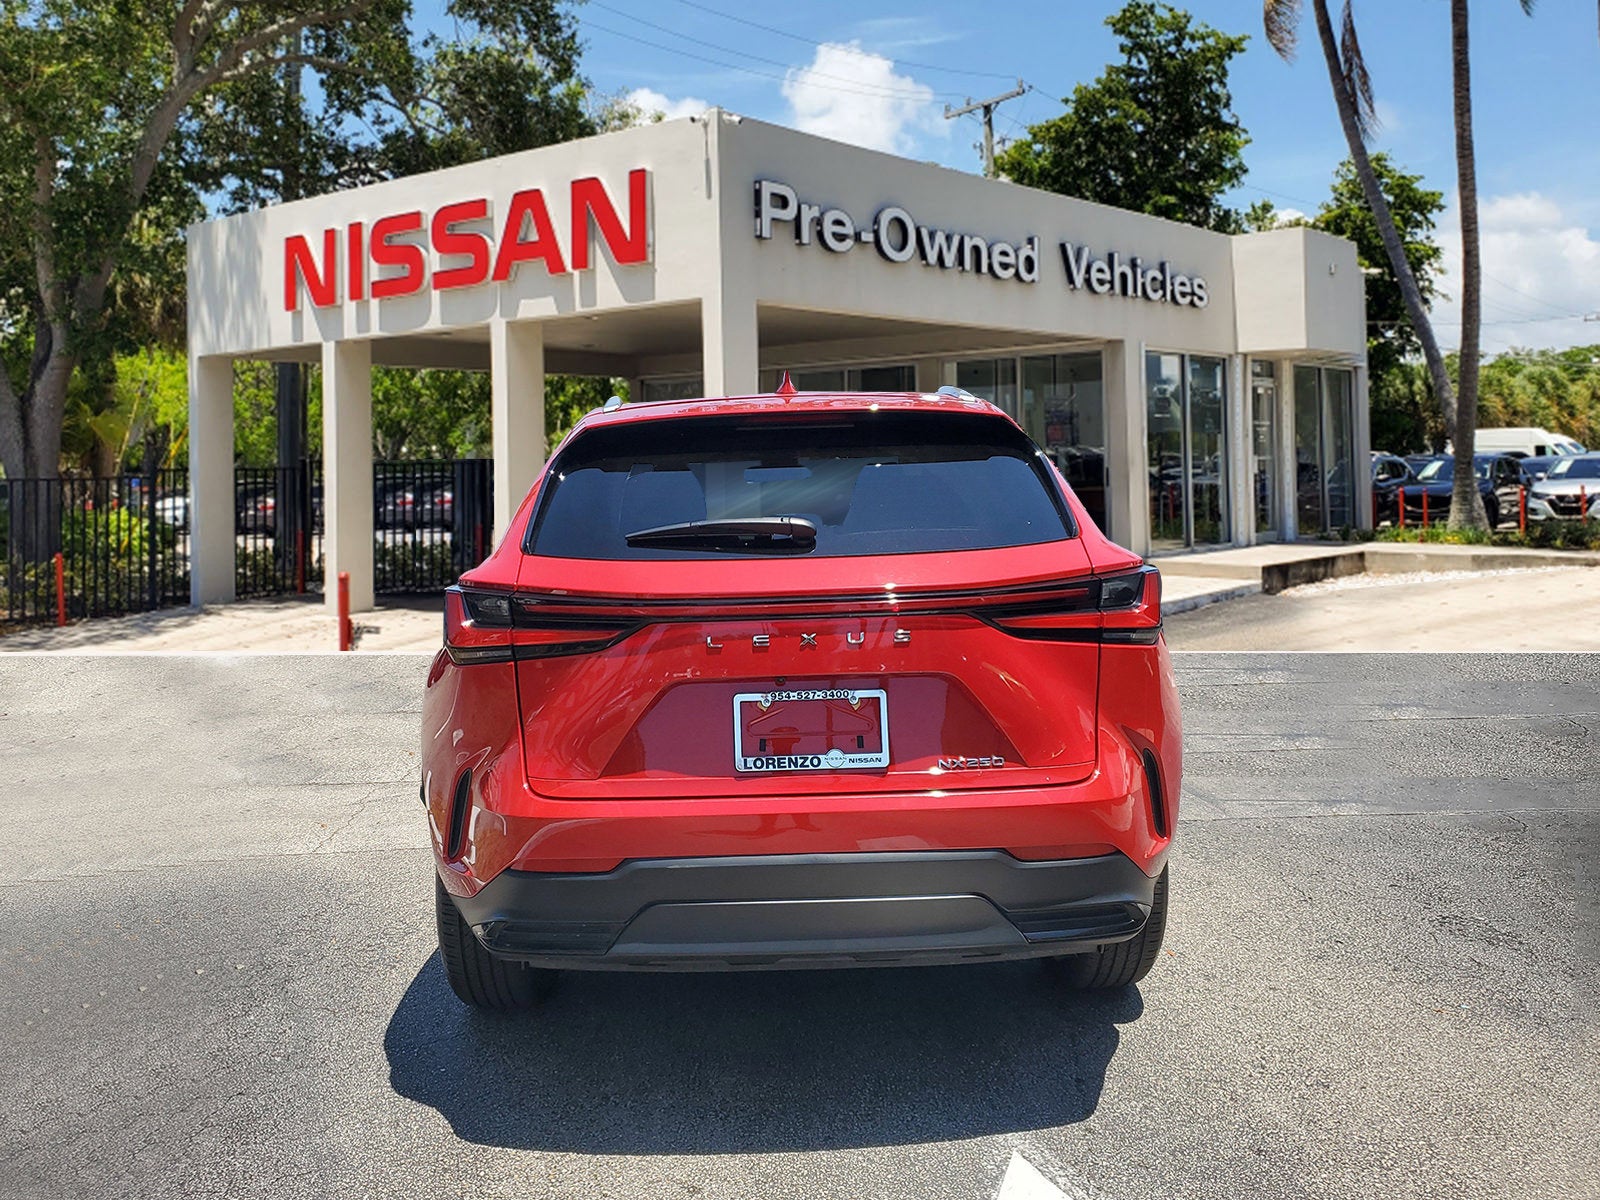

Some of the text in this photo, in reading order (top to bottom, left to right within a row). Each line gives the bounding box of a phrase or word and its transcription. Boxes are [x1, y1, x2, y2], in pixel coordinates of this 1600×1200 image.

[284, 168, 648, 313] NISSAN
[754, 180, 1209, 308] Pre-Owned Vehicles
[706, 629, 911, 648] LEXUS
[770, 690, 850, 700] 954-527-3400
[743, 756, 822, 770] LORENZO
[937, 755, 1005, 769] NX250
